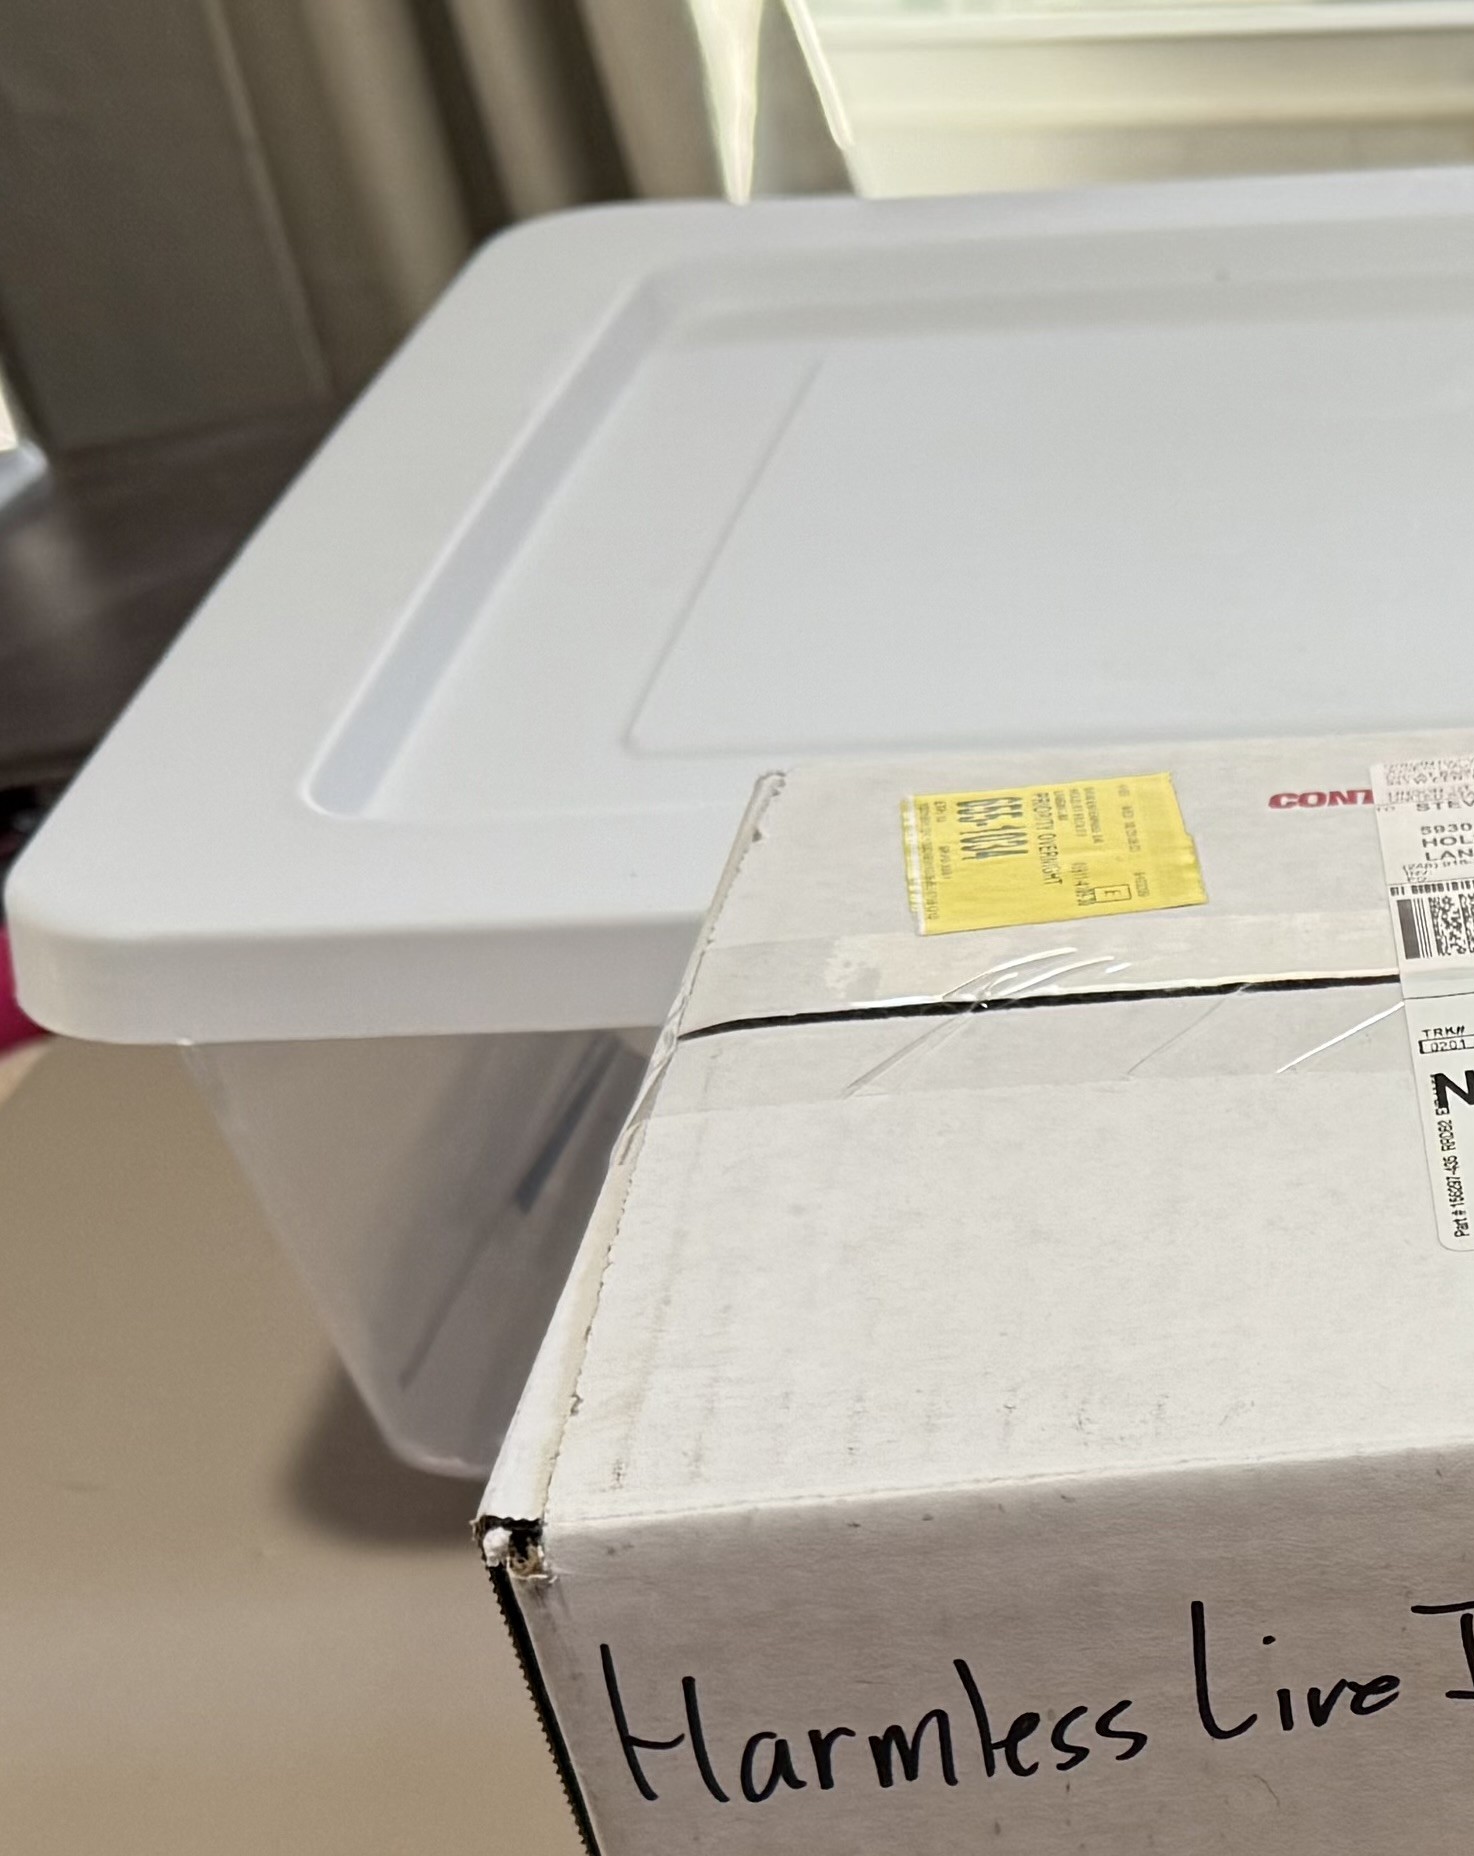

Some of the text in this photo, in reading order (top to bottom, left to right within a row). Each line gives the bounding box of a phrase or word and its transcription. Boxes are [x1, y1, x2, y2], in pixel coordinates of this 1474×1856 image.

[1032, 793, 1055, 831] PRIORITY
[1420, 823, 1473, 836] 5930
[1037, 833, 1063, 885] OVERNIGHT
[1453, 1217, 1470, 1238] Part
[600, 1643, 1149, 1803] Harmless
[1190, 1600, 1400, 1740] Live
